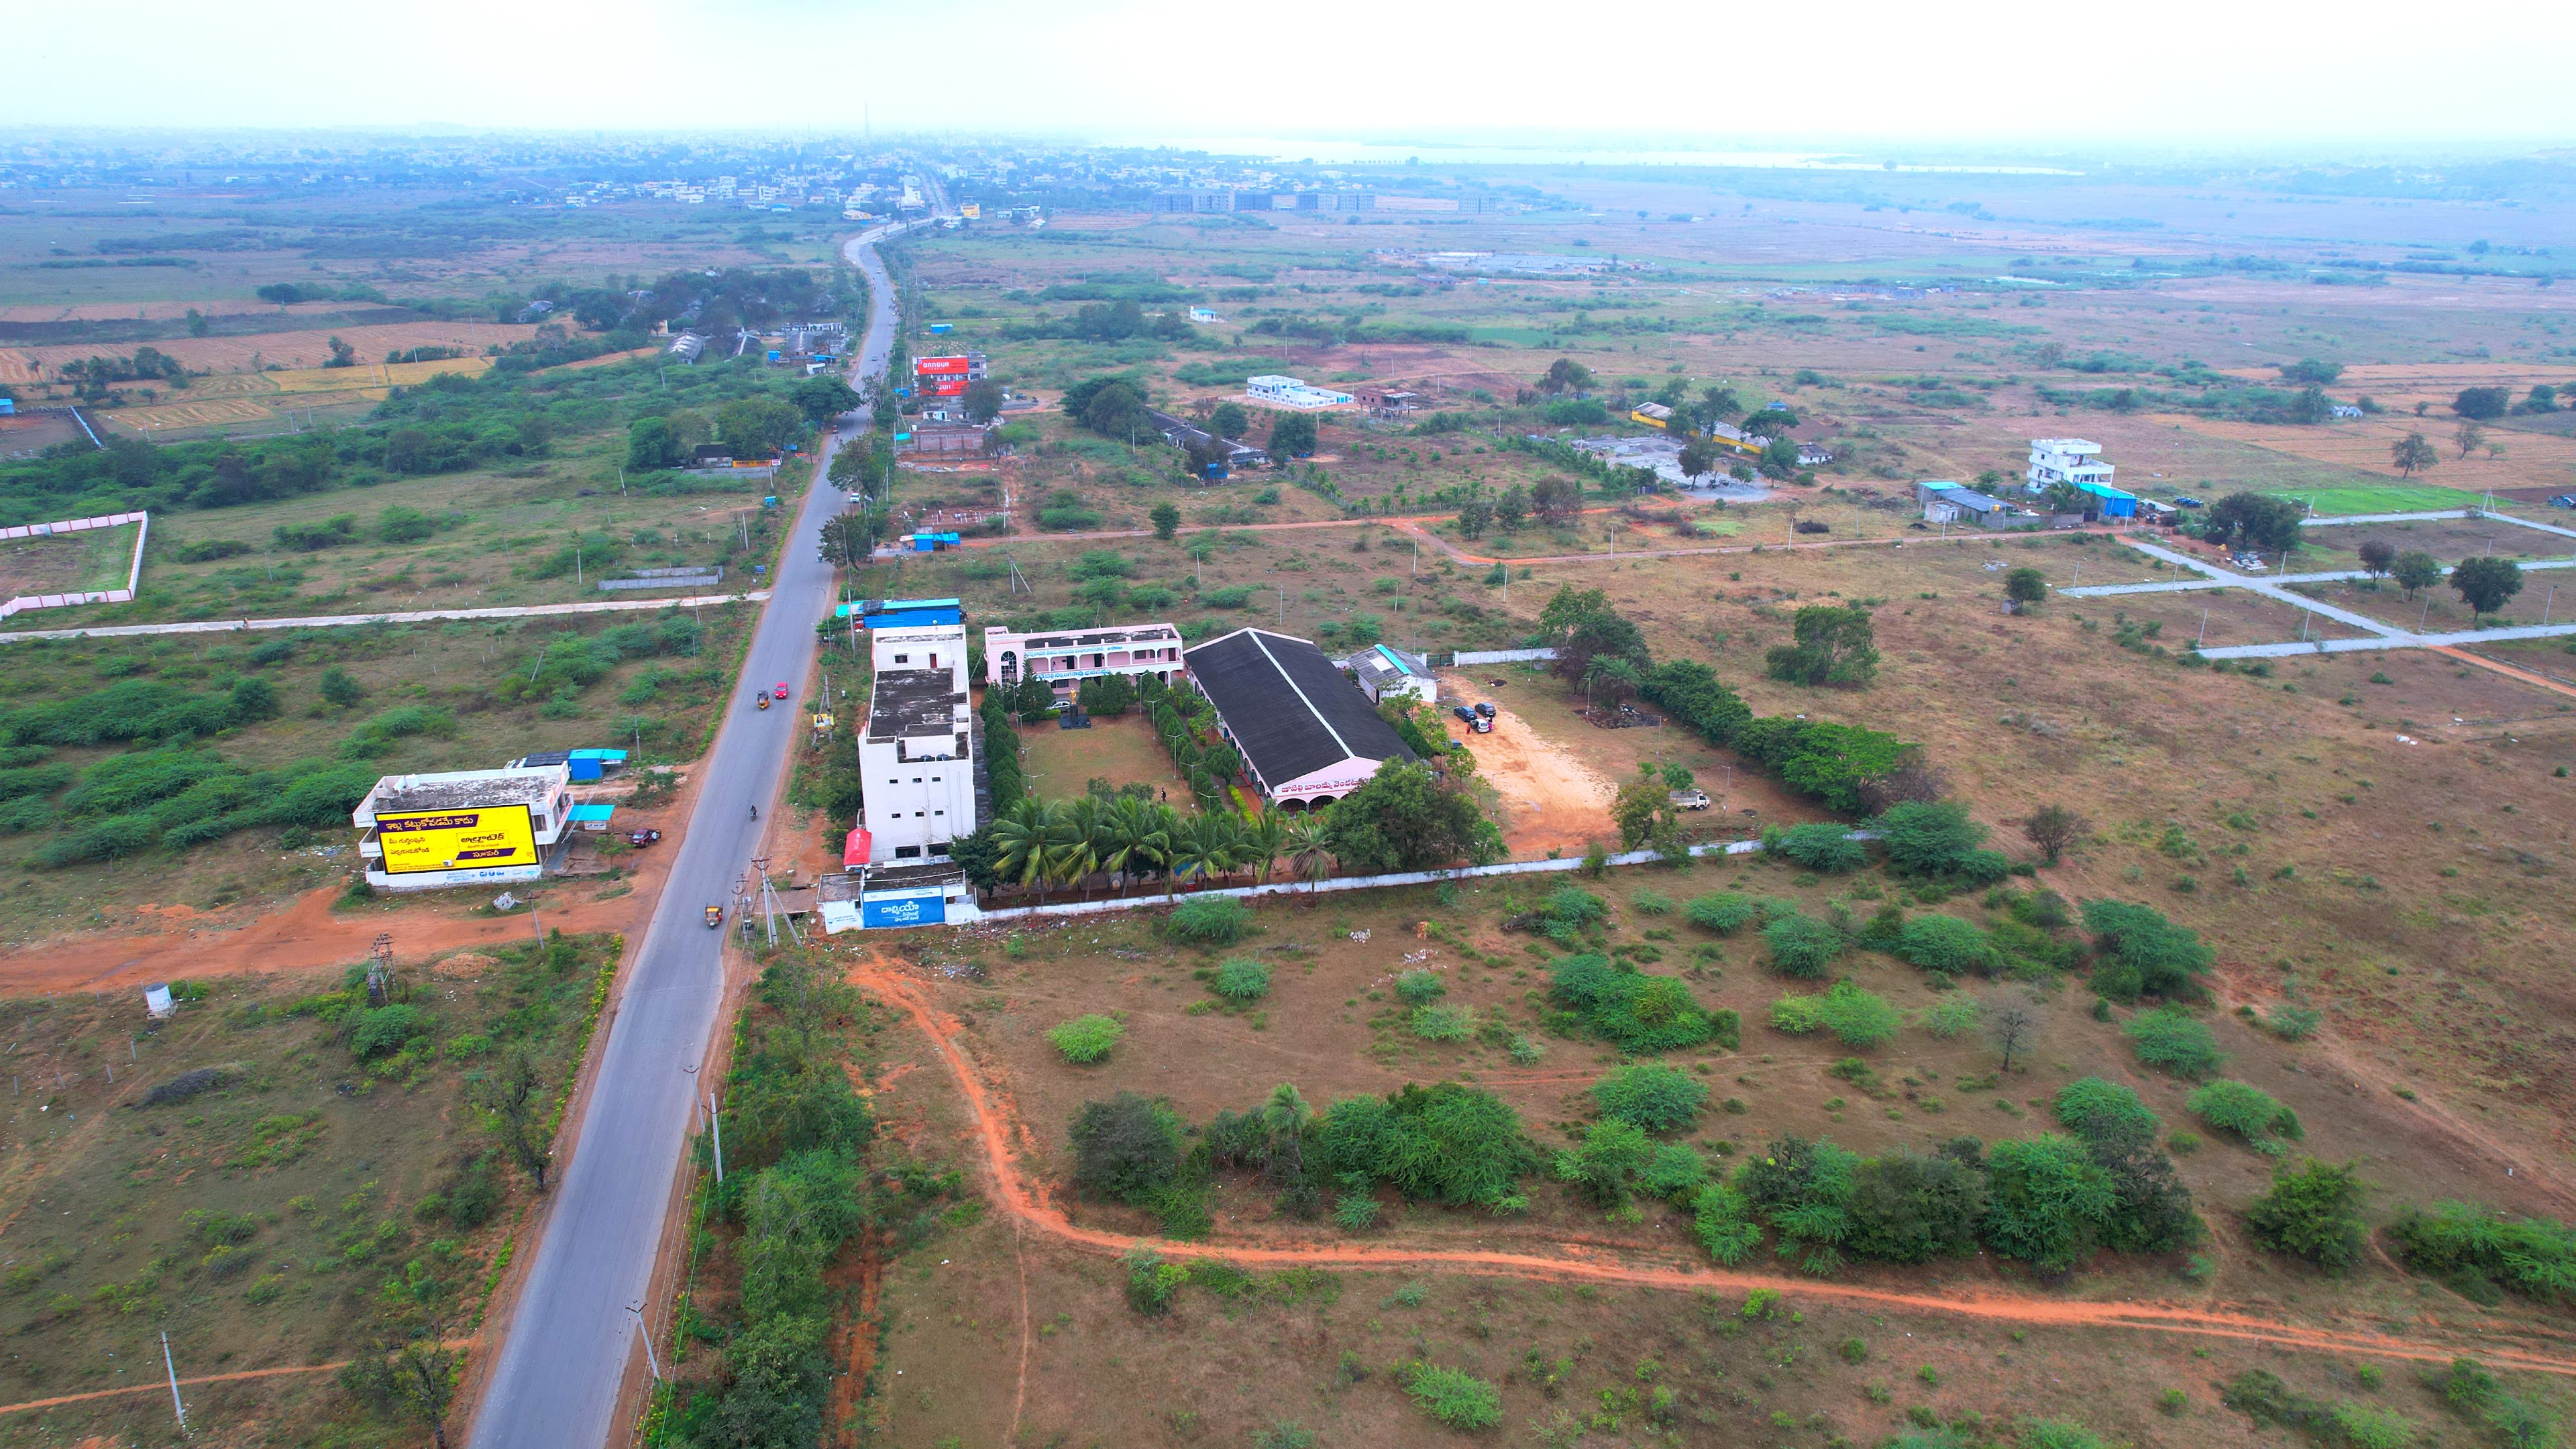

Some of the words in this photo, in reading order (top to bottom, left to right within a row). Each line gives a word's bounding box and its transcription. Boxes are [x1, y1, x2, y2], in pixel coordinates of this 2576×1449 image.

[1305, 782, 1333, 790] బాలమ్మ
[386, 822, 402, 830] ఇల్లు
[404, 816, 453, 830] కట్టుకోవడమే
[454, 816, 474, 825] కాదు
[472, 849, 500, 858] సూపర్
